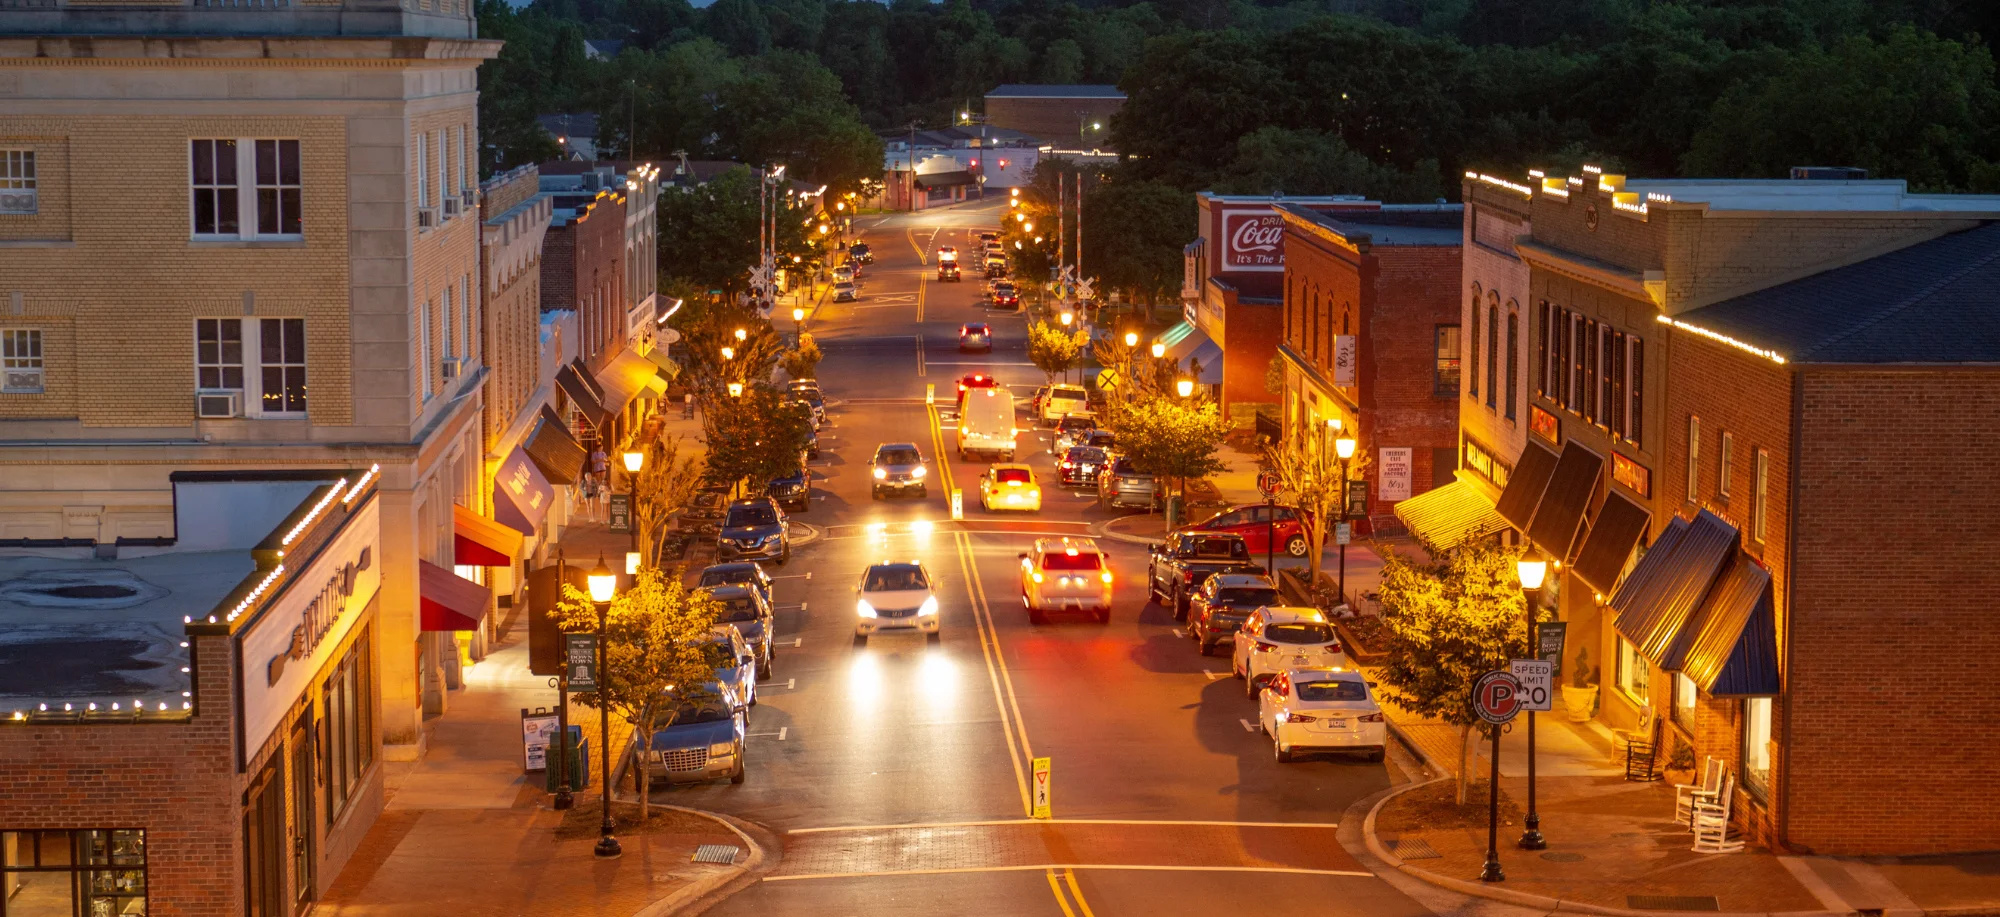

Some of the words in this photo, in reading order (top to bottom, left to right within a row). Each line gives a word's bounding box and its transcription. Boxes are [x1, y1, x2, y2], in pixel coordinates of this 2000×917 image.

[1231, 219, 1283, 252] Coca
[1236, 254, 1252, 264] It's
[1256, 254, 1274, 264] The
[1514, 665, 1549, 675] SPEED
[1483, 673, 1499, 684] PUBLIC
[1500, 673, 1518, 684] PARKING
[1491, 684, 1513, 710] P
